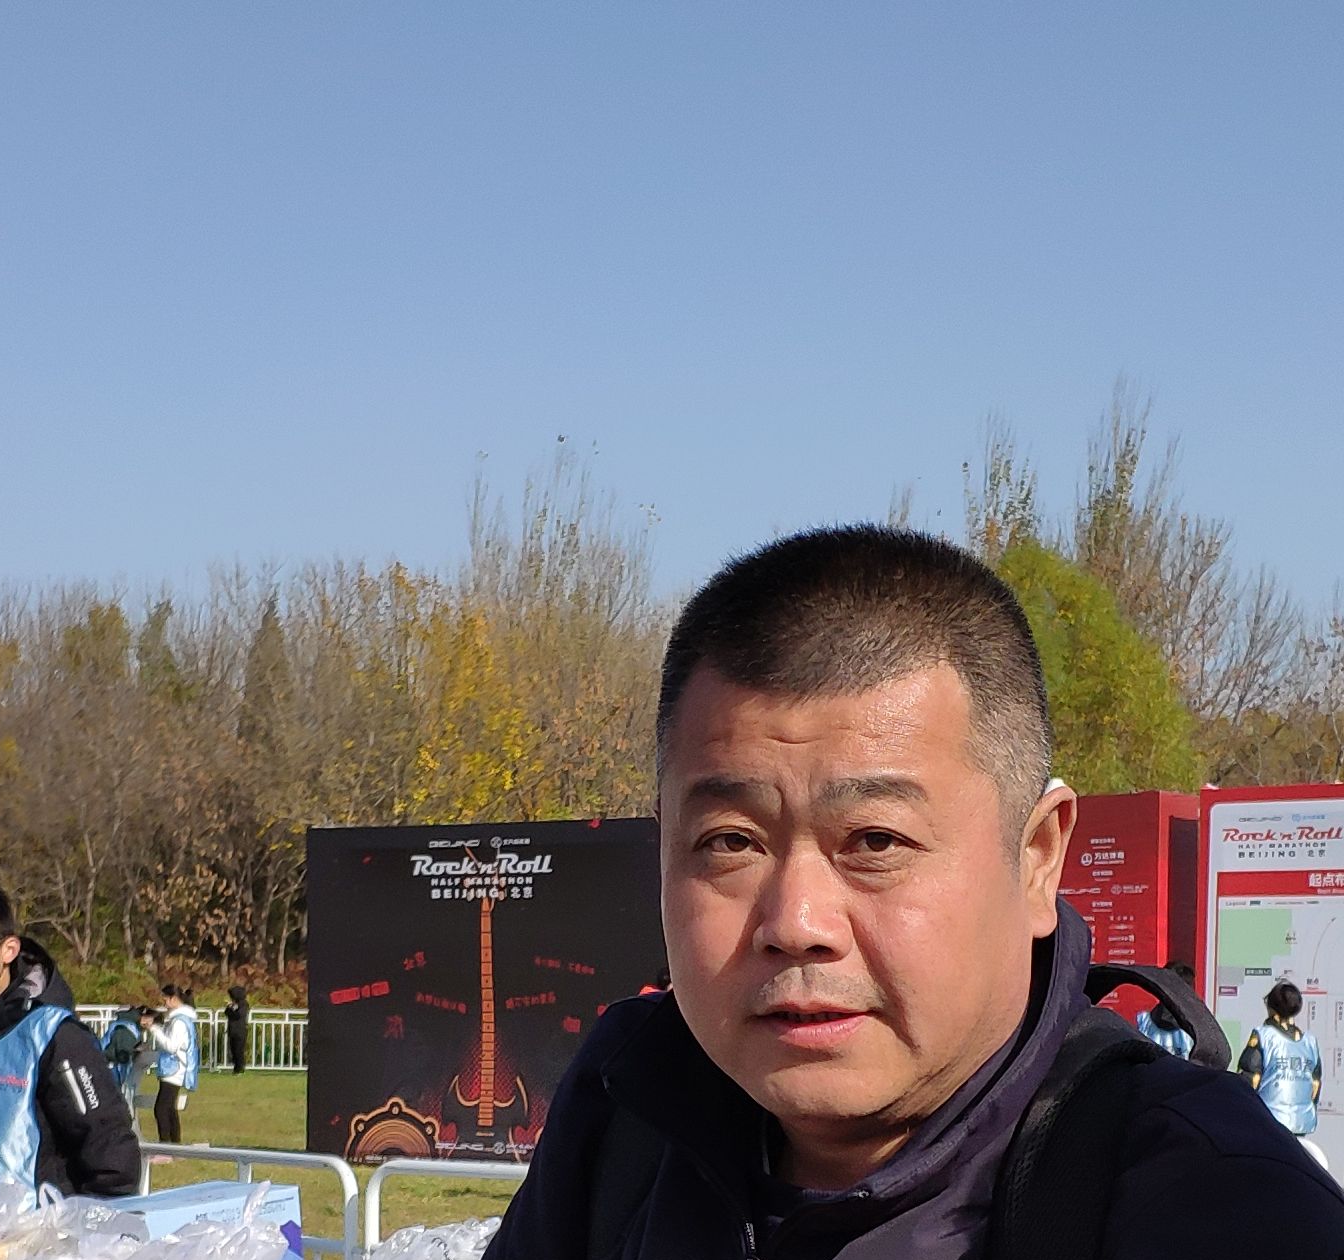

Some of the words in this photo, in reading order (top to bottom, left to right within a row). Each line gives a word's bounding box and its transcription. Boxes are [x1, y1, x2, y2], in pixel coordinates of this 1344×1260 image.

[1238, 850, 1296, 858] BEIJING
[431, 888, 499, 899] BEIJING
[78, 1065, 100, 1110] salomon
